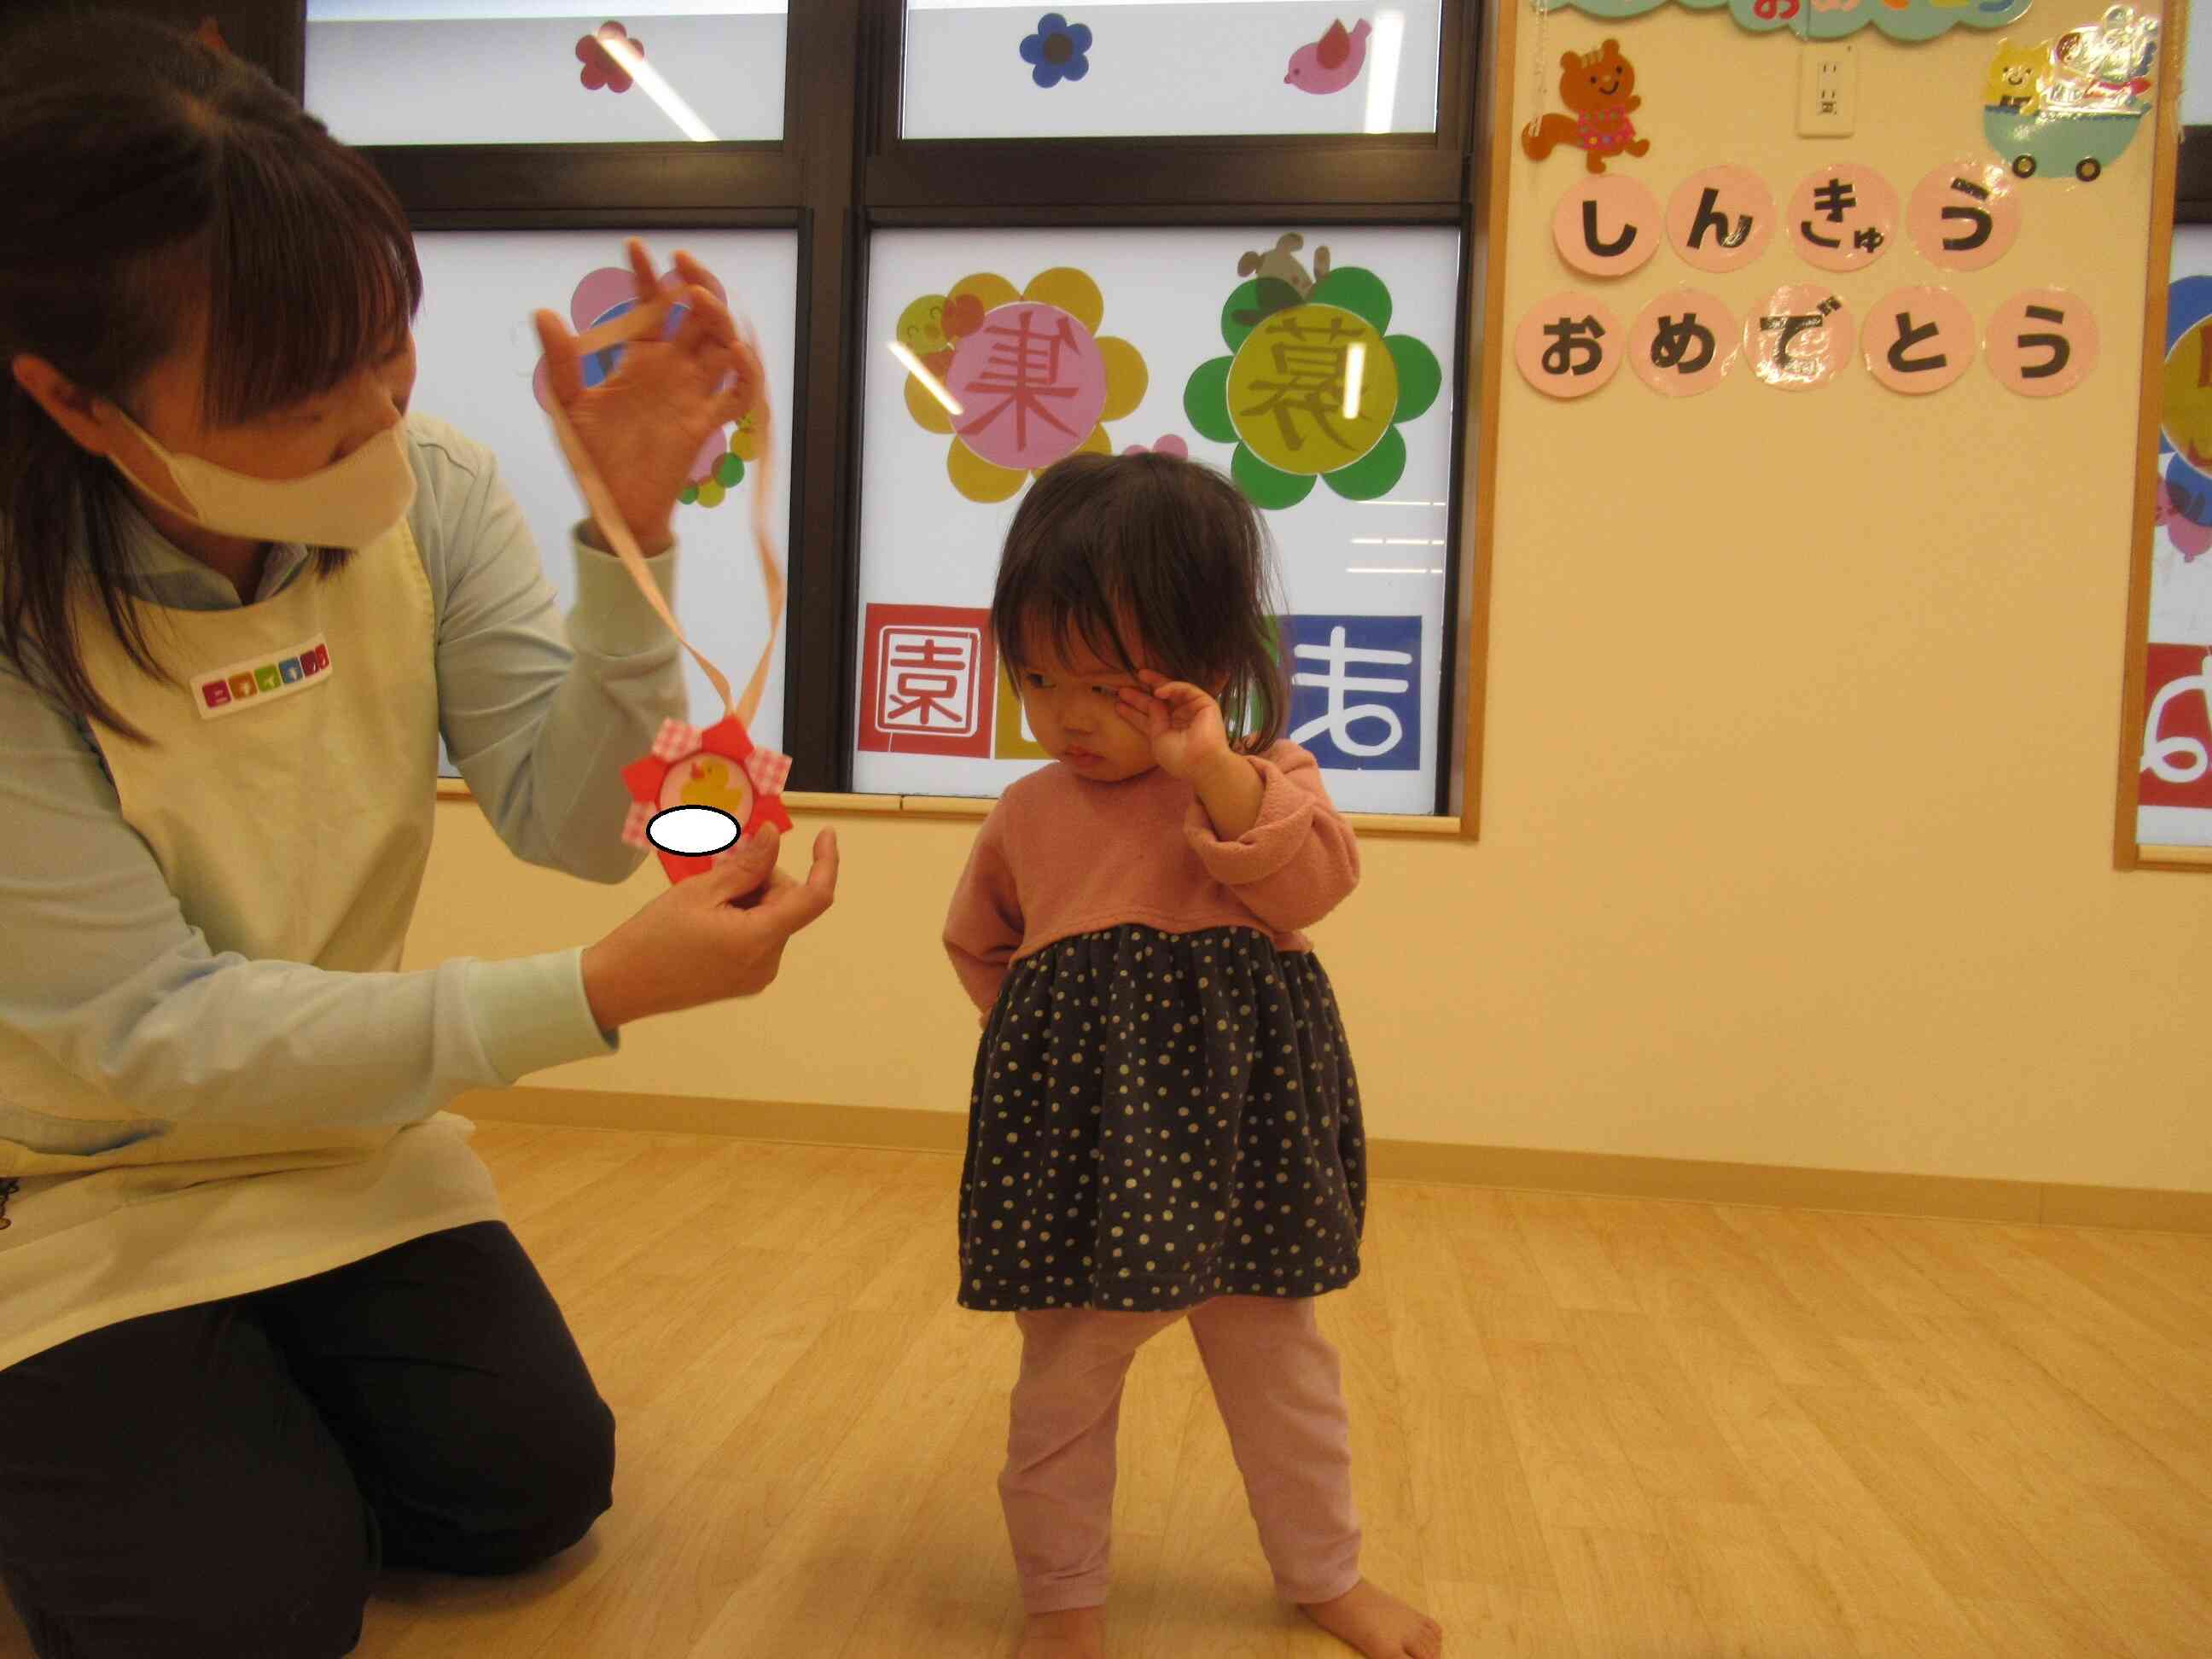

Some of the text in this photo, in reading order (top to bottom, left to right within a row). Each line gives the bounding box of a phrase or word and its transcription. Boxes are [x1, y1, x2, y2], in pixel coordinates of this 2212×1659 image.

[1582, 177, 1994, 256] しんきゅう
[1541, 296, 2070, 378] おめでとう
